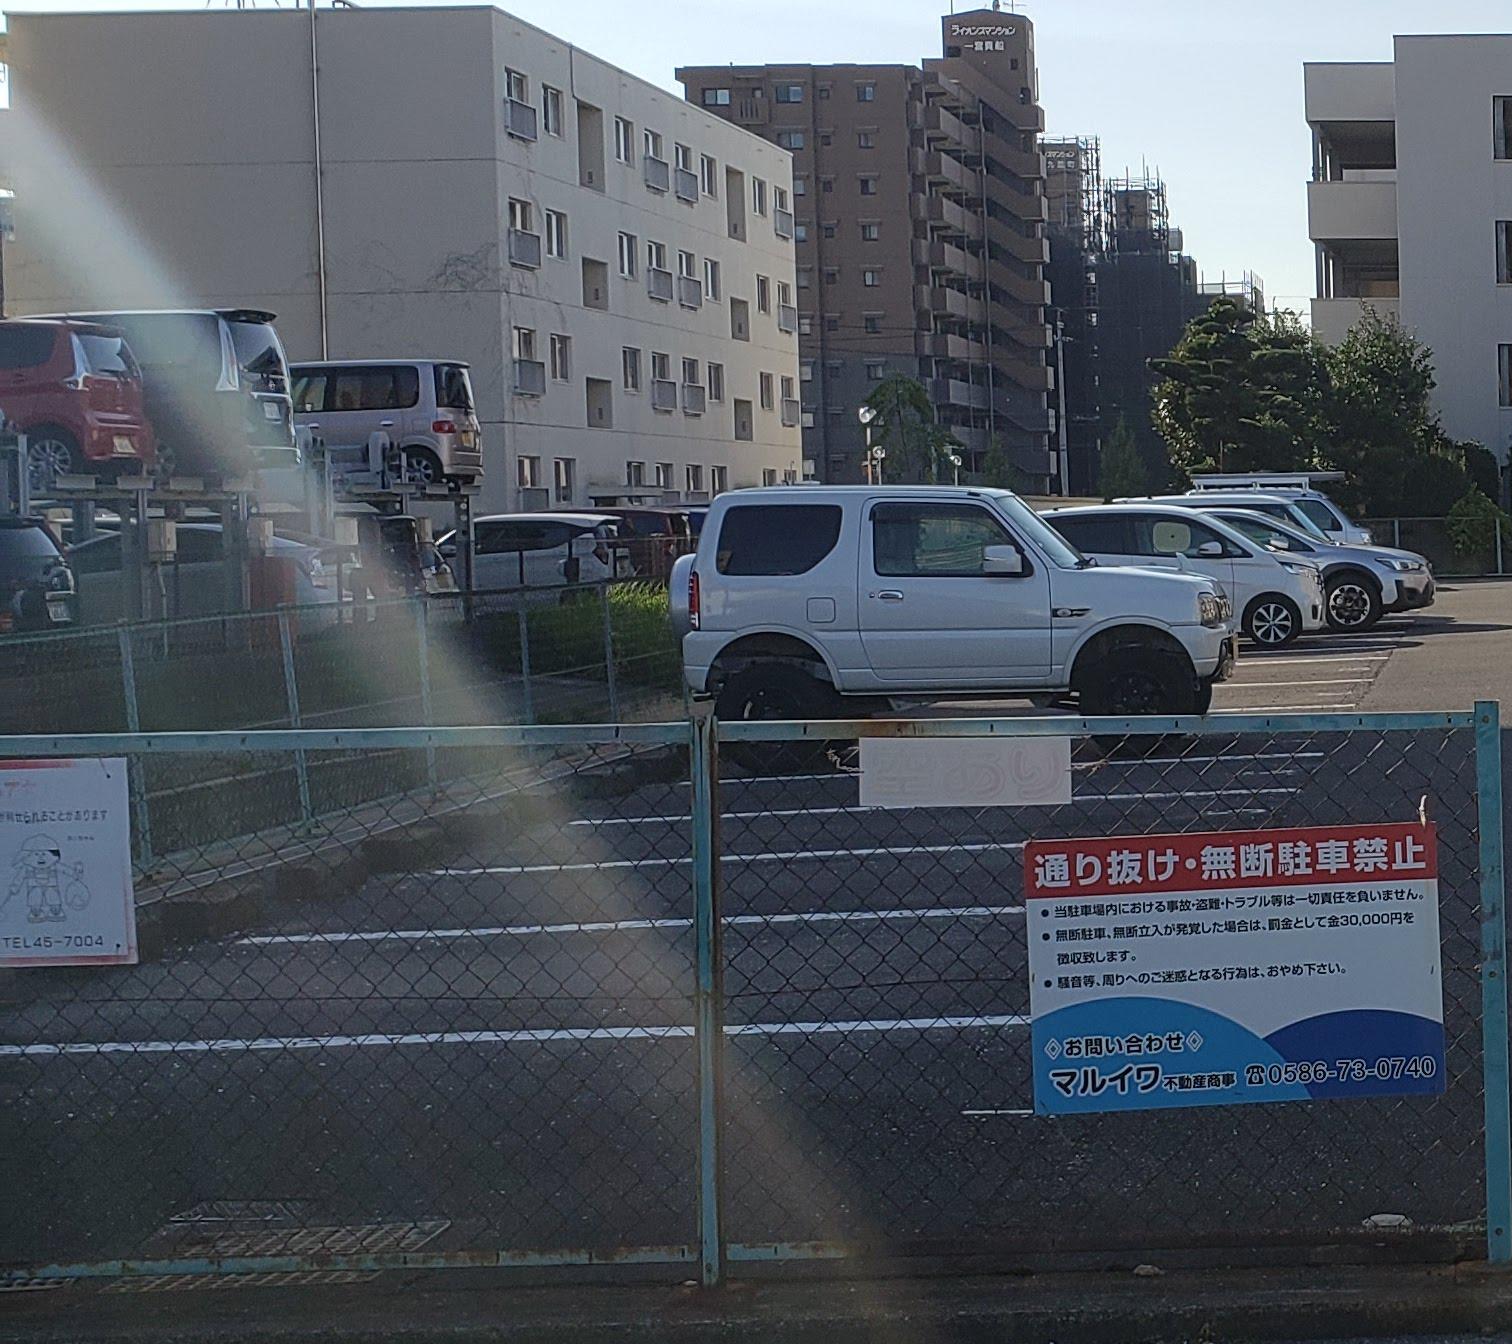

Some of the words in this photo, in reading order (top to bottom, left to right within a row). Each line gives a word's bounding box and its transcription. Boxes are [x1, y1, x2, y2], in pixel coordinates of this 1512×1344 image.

[1034, 835, 1427, 889] 通り抜け・無断駐車禁止
[1064, 1031, 1184, 1058] お問い合わせ
[1049, 1063, 1161, 1097] マルイワ
[1267, 1055, 1436, 1086] 0586-73-0740
